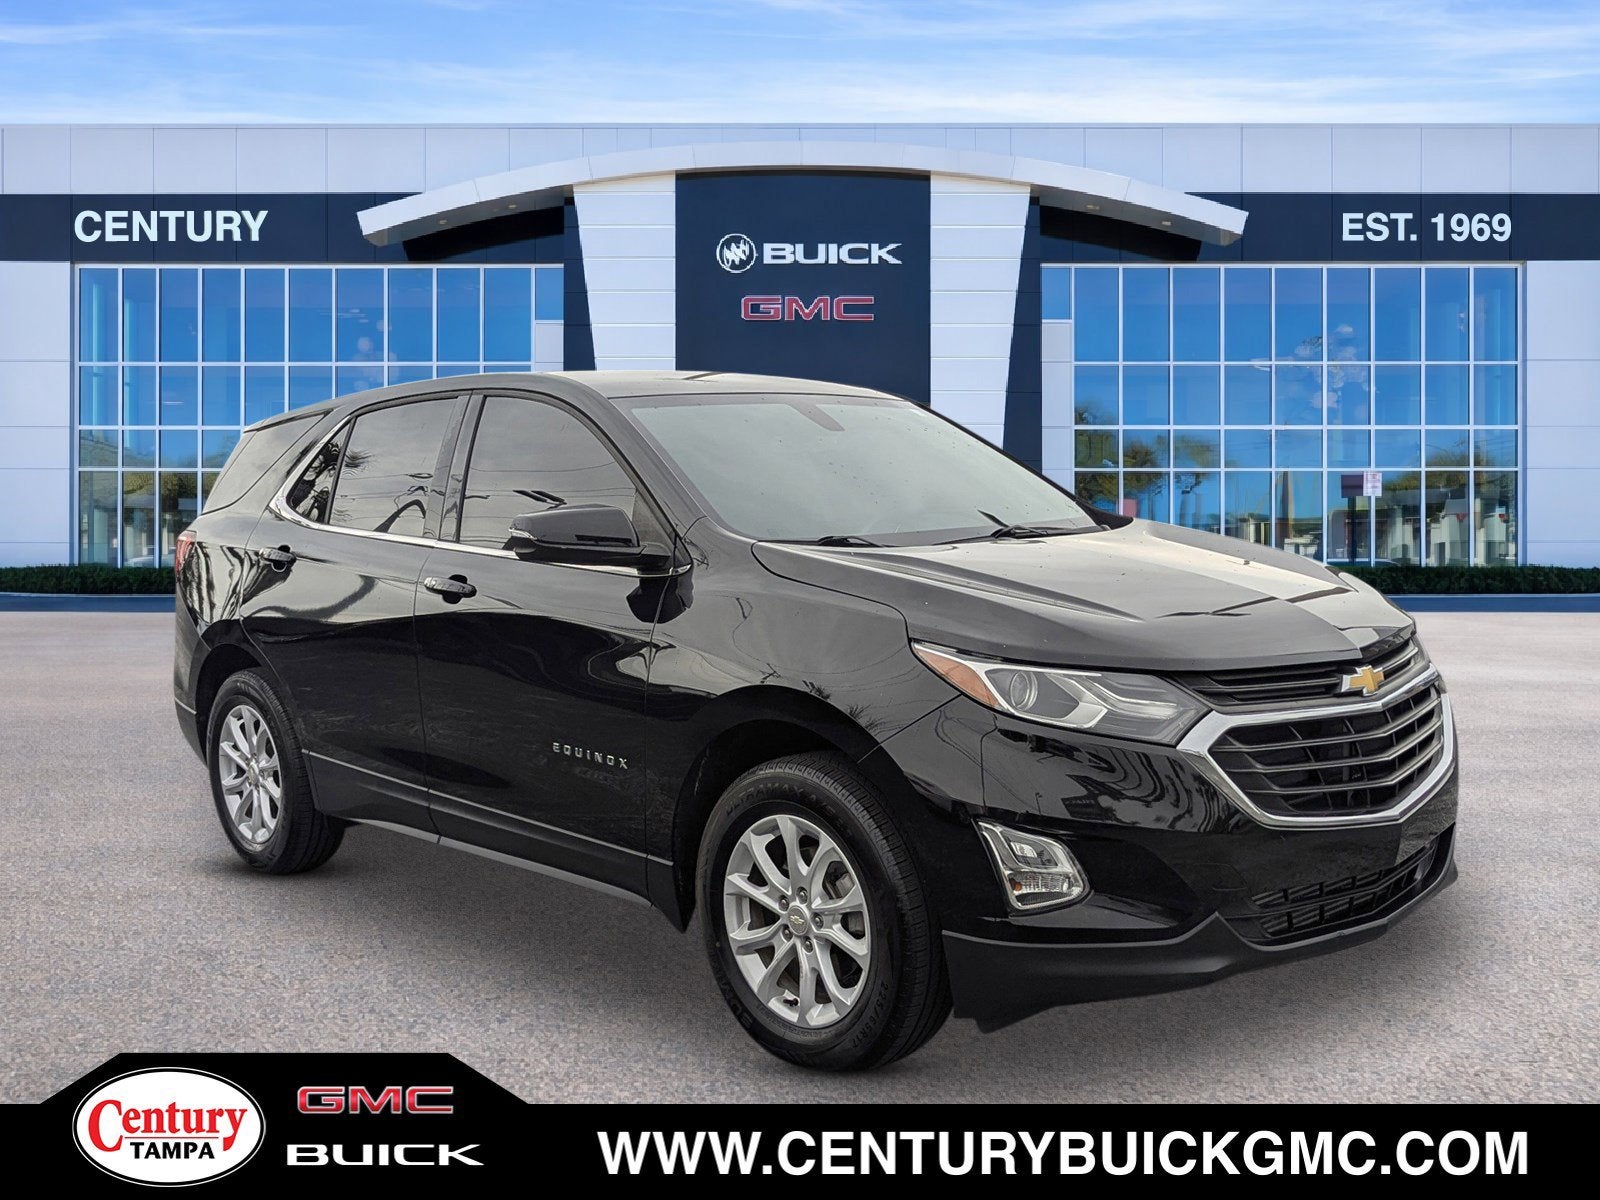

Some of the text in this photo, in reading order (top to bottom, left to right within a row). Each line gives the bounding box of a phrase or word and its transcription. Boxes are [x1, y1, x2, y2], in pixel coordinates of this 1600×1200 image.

[74, 210, 268, 242] CENTURY
[1342, 212, 1512, 242] EST. 1969
[763, 242, 903, 265] BUICK
[741, 294, 875, 321] GMC
[552, 742, 628, 769] EQUINOX
[852, 980, 889, 1048] 225/65R17
